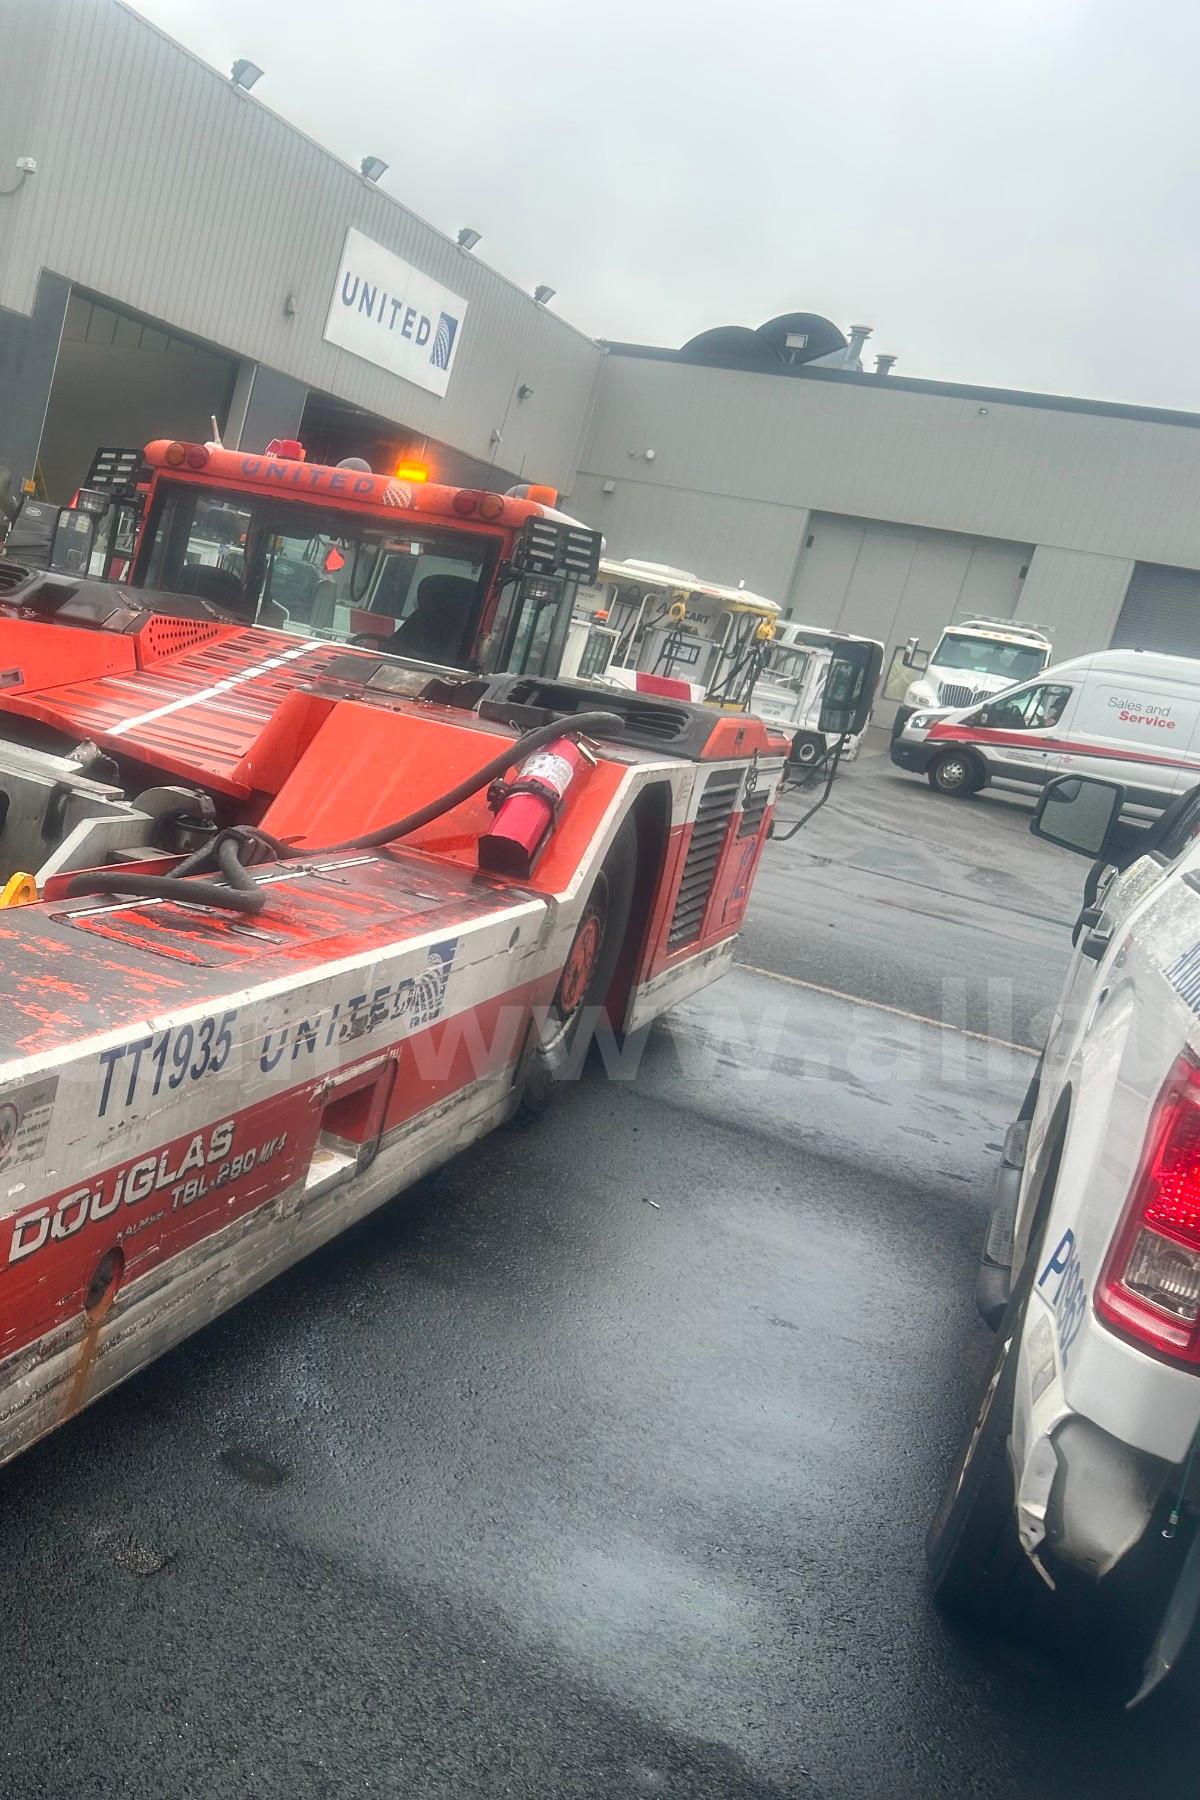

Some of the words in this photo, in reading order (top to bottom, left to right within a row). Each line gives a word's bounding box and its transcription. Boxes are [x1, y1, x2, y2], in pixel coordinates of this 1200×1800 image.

[342, 271, 431, 346] UNITED
[242, 458, 375, 494] UNITED
[1107, 696, 1142, 712] Sales
[1145, 702, 1171, 717] and
[1118, 711, 1176, 729] Service
[98, 1010, 237, 1118] TT1935
[259, 976, 416, 1073] UNITED
[8, 1119, 236, 1263] DOUGLAS
